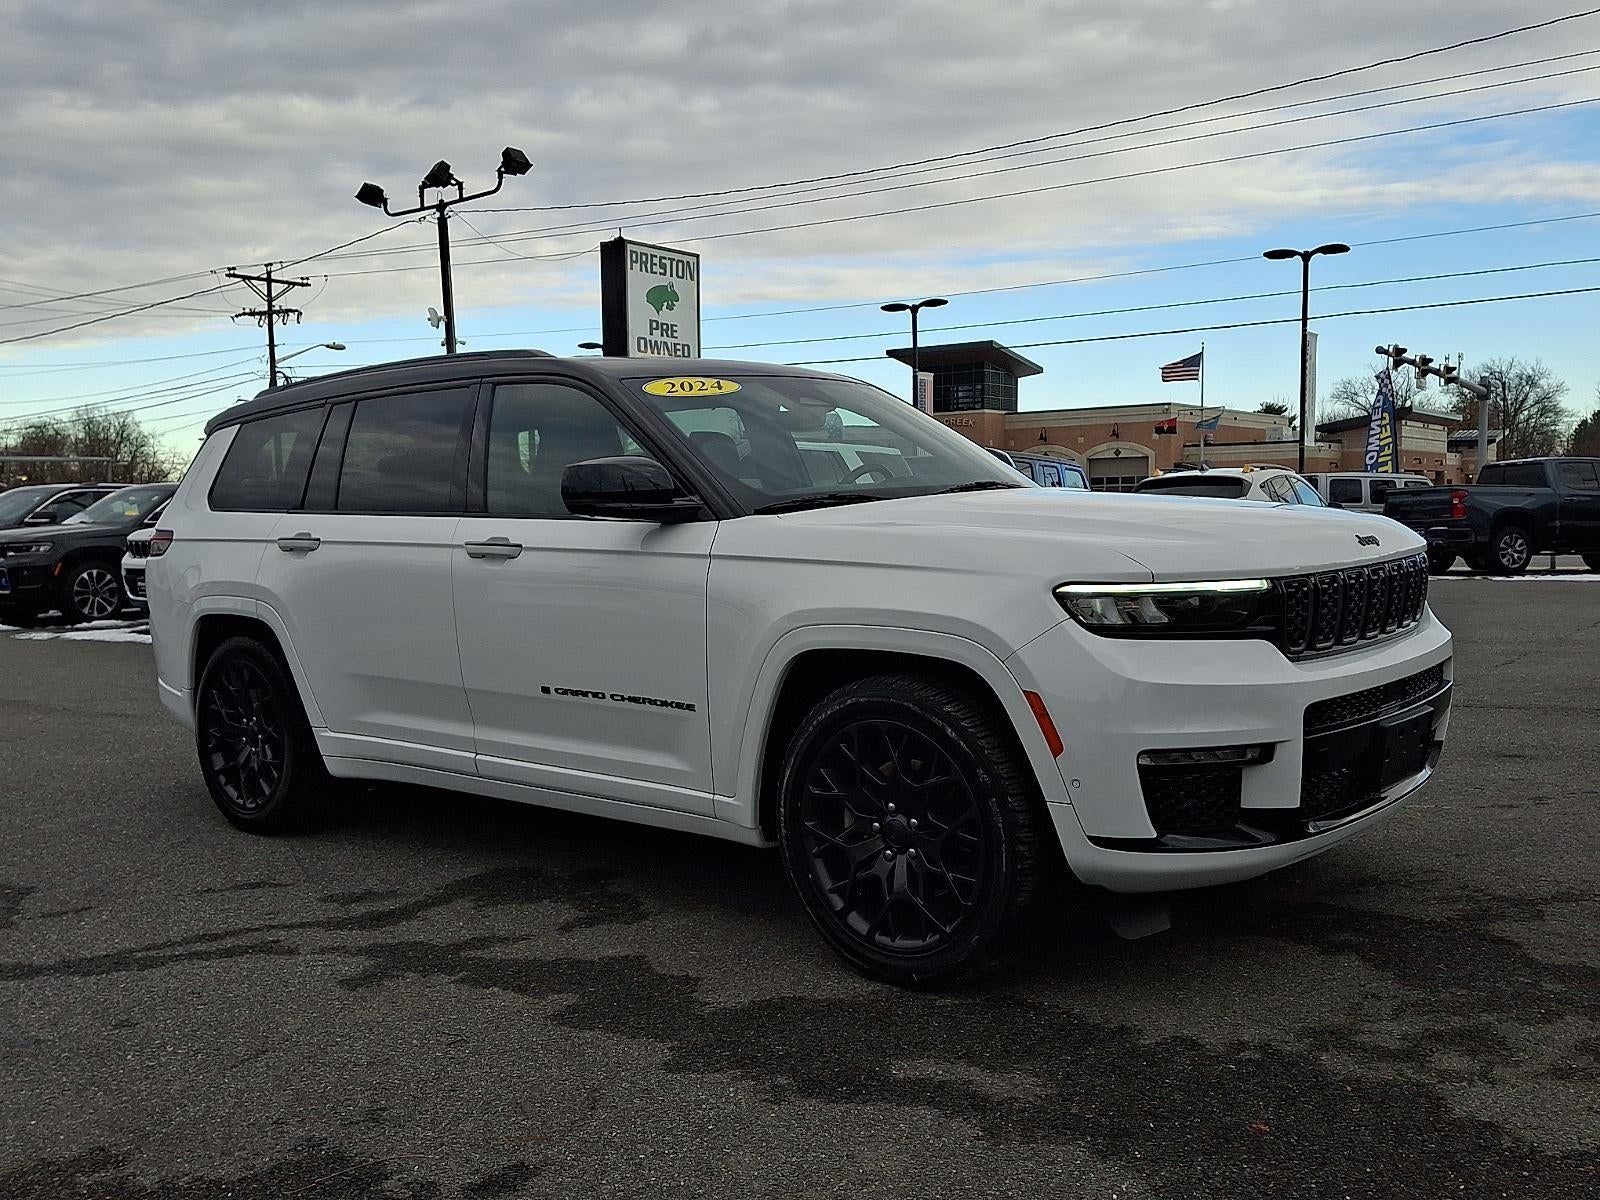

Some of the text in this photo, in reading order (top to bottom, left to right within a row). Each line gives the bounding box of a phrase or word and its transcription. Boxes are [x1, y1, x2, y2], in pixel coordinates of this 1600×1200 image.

[629, 249, 695, 281] PRESTON
[649, 319, 678, 339] PRE
[637, 336, 691, 358] OWNED
[663, 380, 724, 394] 2024
[943, 417, 976, 428] CREEK
[554, 687, 697, 713] GRAND CHEROKEE
